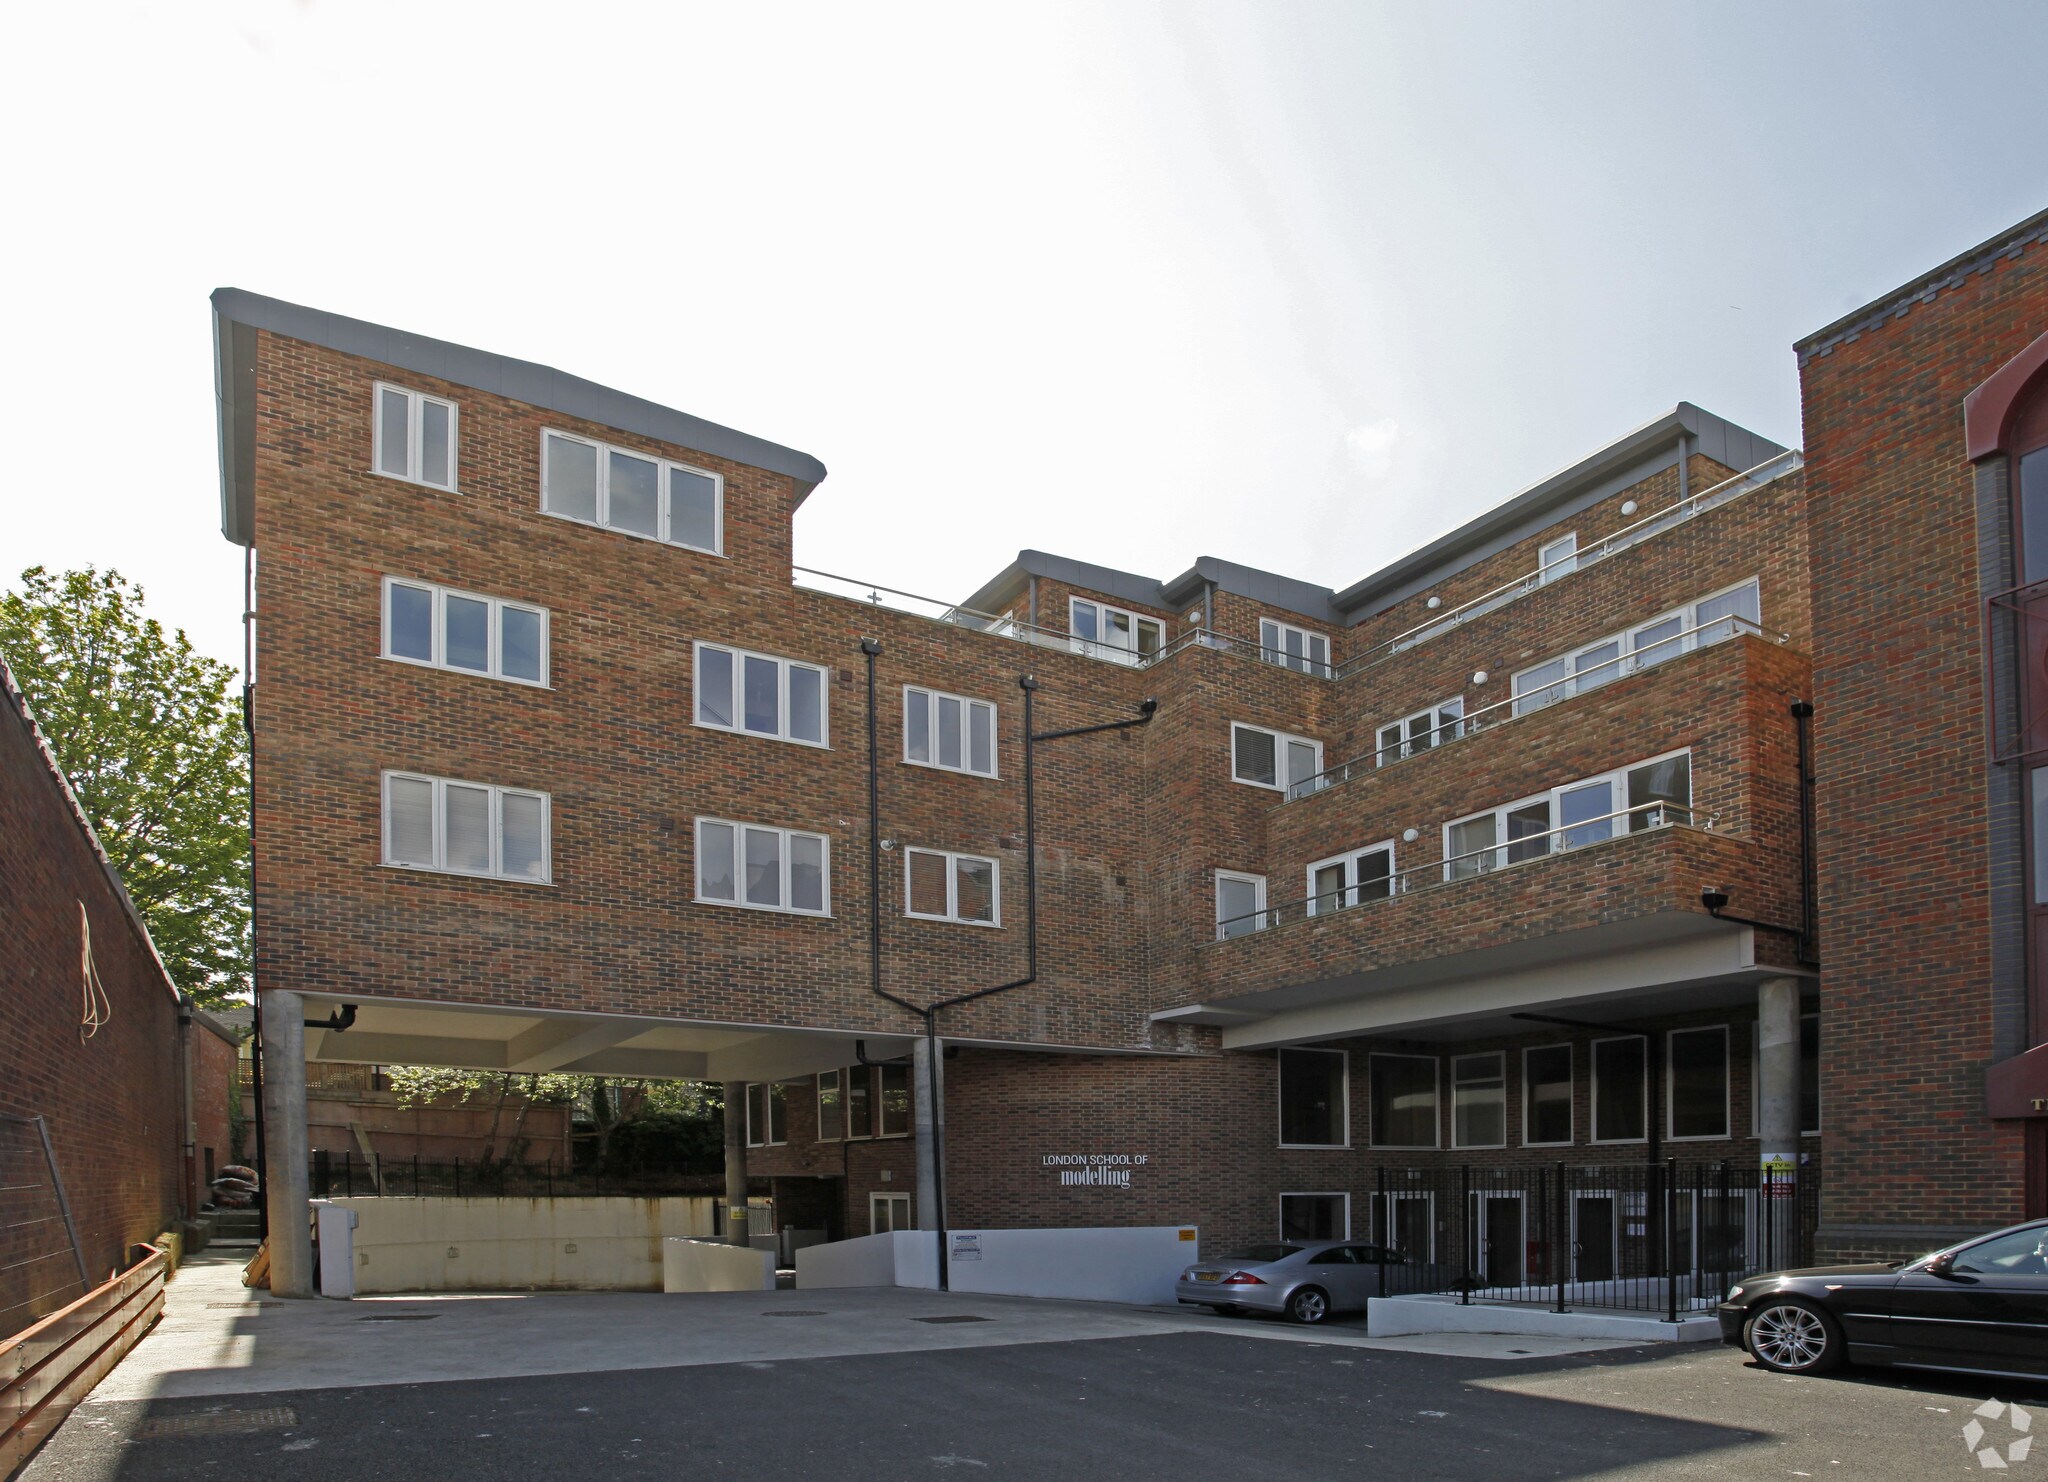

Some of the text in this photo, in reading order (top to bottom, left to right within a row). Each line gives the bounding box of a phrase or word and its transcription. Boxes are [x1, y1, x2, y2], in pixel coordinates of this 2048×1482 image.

[1042, 1154, 1149, 1166] LONDON SCHOOL OF
[1060, 1165, 1131, 1190] modelling
